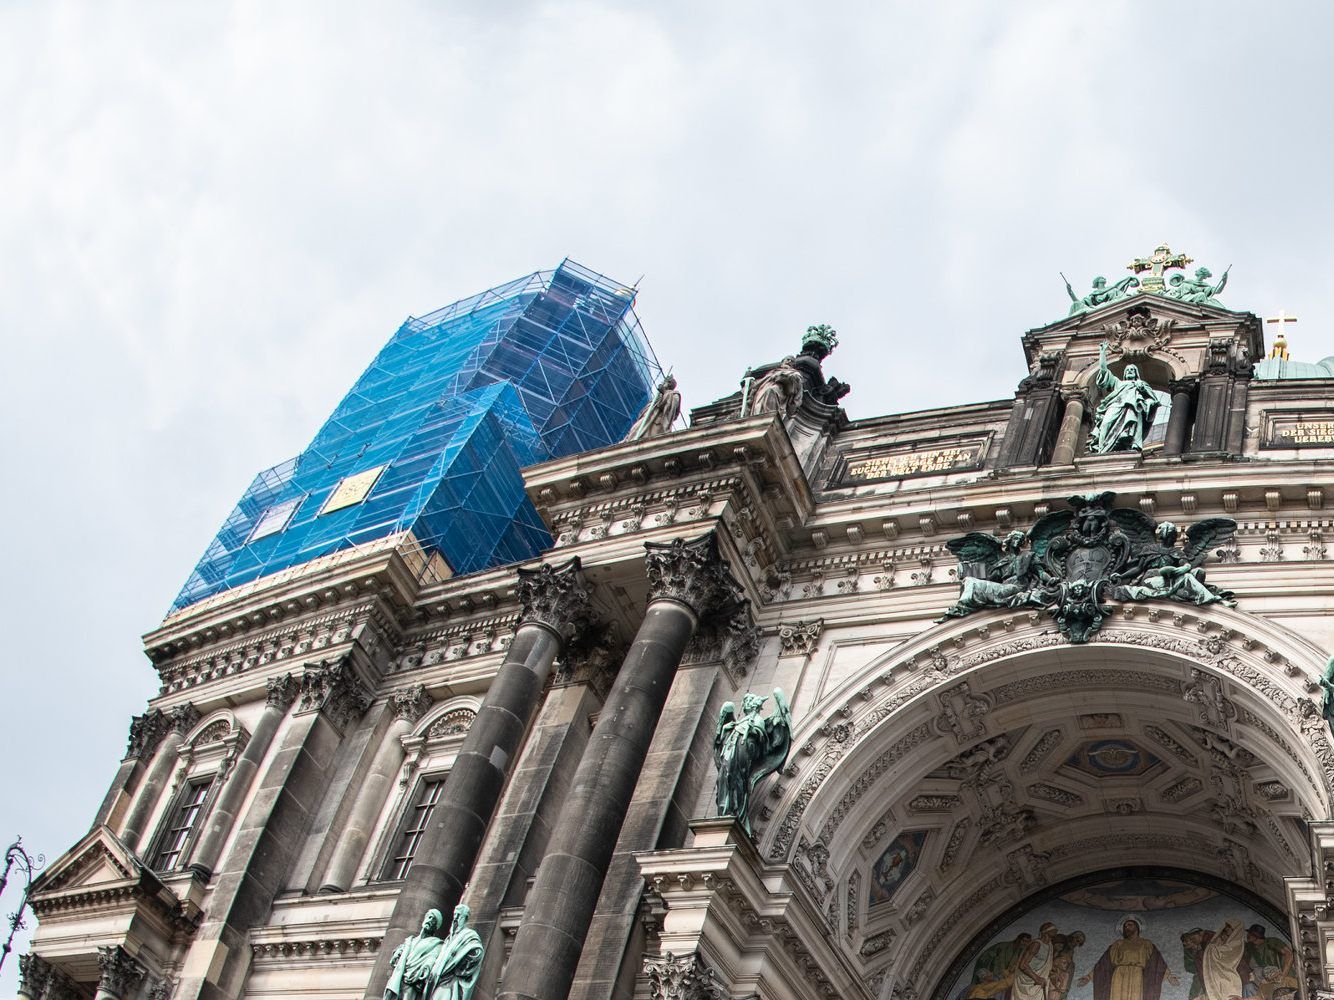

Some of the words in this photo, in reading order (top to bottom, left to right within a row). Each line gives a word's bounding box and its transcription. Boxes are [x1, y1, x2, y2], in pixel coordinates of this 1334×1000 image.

[1281, 429, 1305, 437] DER
[850, 465, 877, 476] EUCH
[937, 454, 954, 463] BIS
[956, 452, 971, 461] AN
[866, 470, 887, 480] DER
[890, 466, 918, 477] WELT
